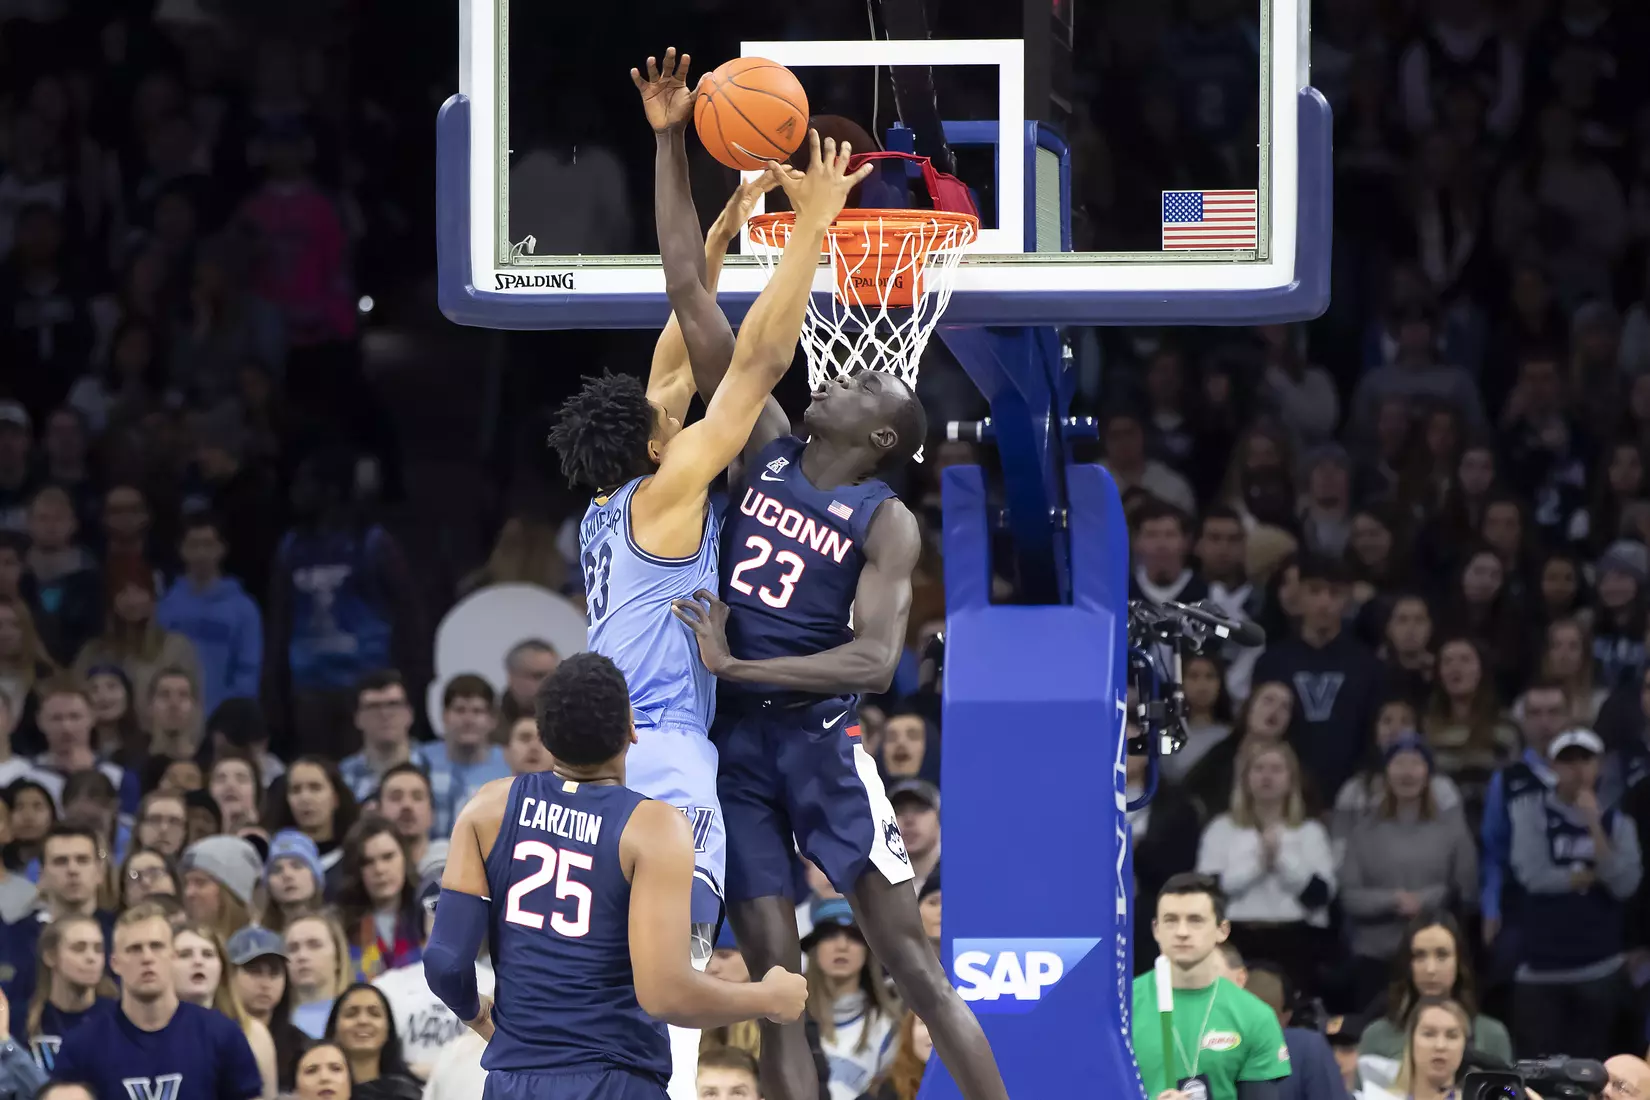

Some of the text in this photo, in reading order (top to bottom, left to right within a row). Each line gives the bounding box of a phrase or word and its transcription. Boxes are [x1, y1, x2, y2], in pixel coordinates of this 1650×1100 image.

[494, 272, 574, 291] SPALDING
[740, 486, 853, 564] UCONN
[730, 535, 806, 608] 23
[1292, 670, 1346, 722] V
[519, 797, 603, 845] CARLTON
[505, 840, 594, 938] 25
[953, 951, 1064, 1001] SAP
